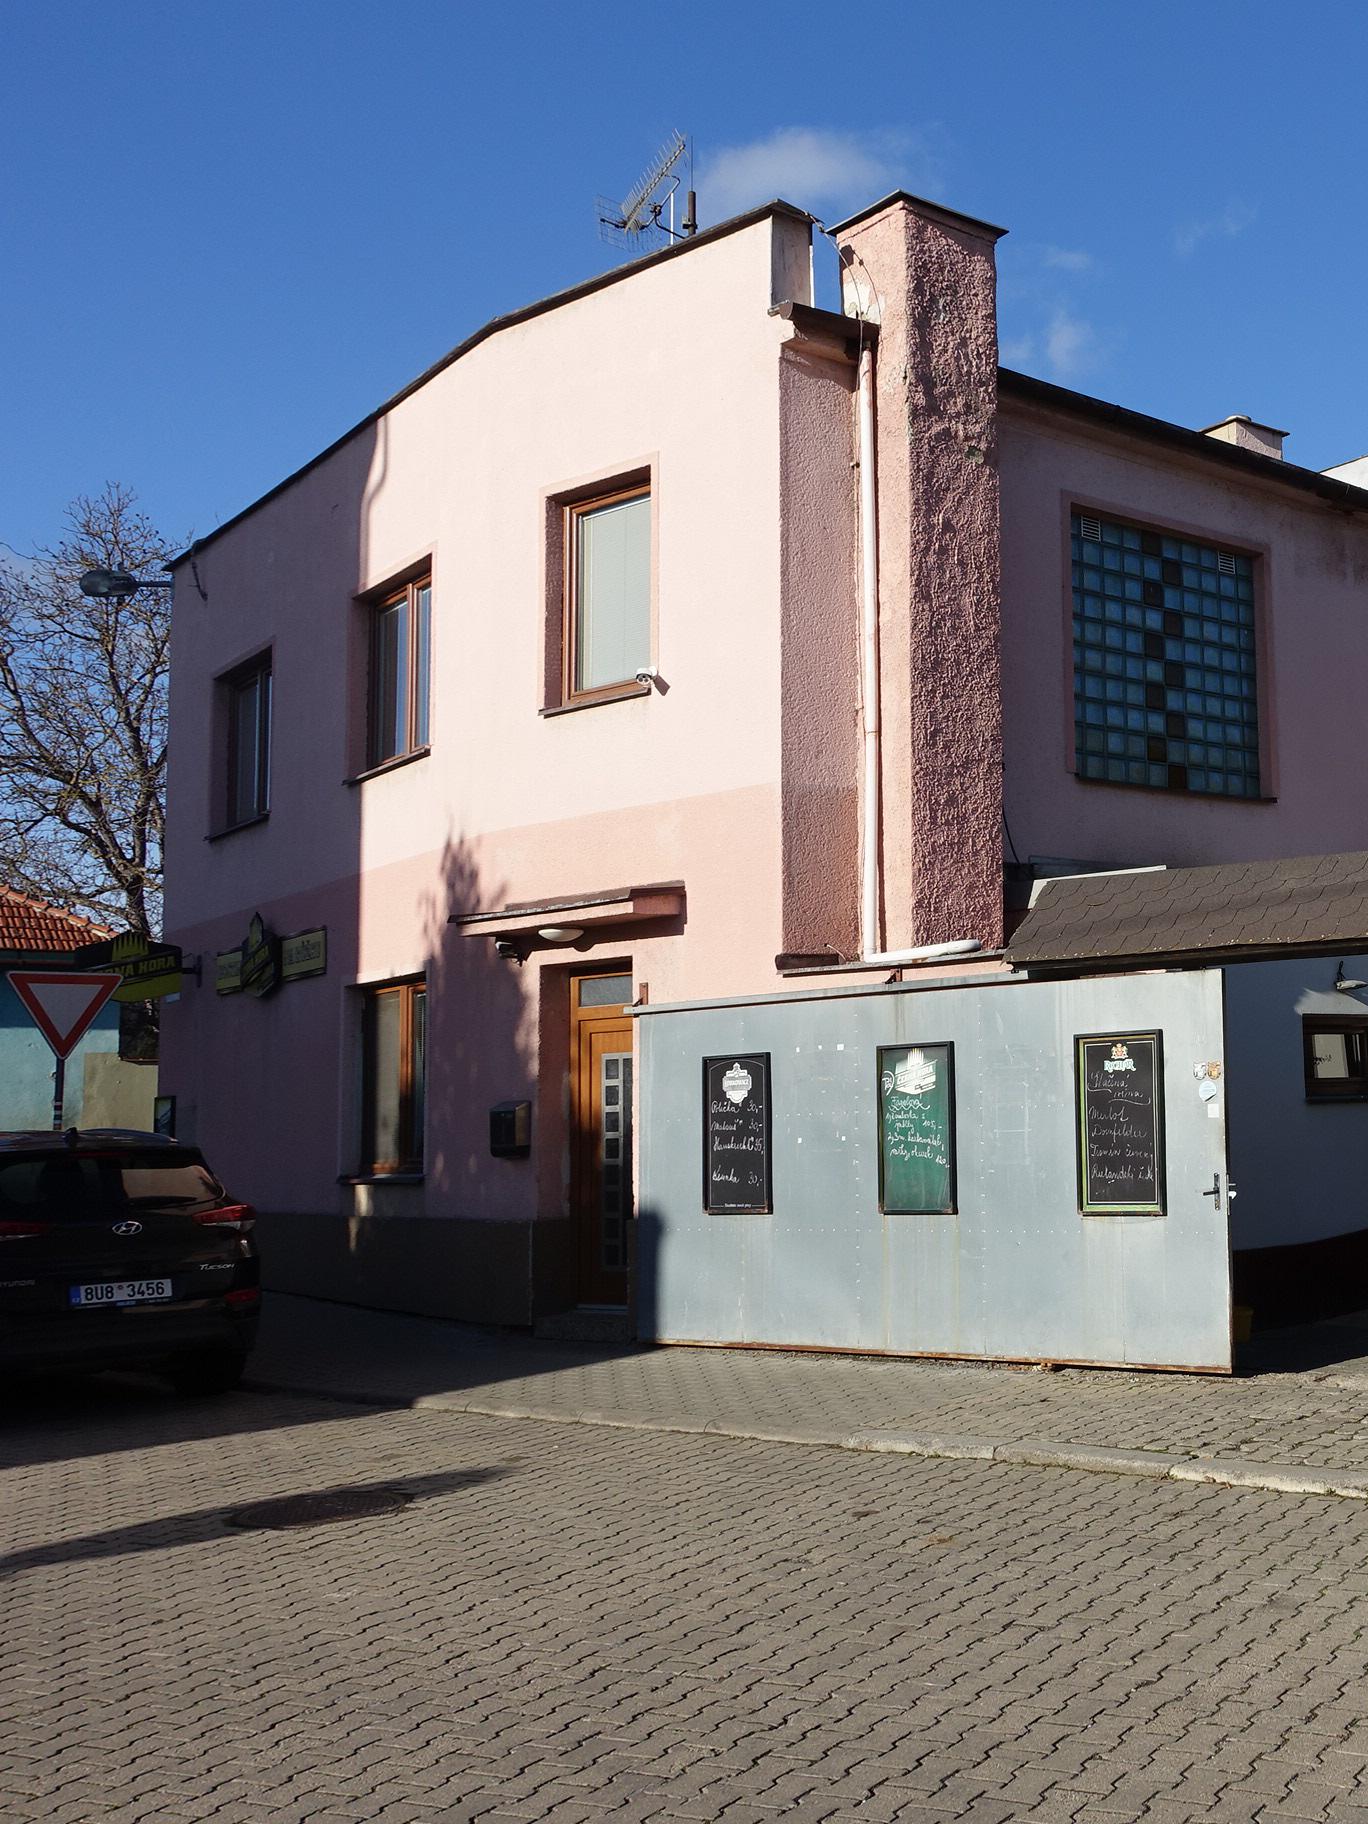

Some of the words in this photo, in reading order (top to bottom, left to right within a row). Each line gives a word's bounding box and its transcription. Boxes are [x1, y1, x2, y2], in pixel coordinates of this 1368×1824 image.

[138, 955, 177, 975] HORA
[199, 1263, 235, 1272] TUCSON
[84, 1285, 114, 1301] 8U8
[127, 1281, 165, 1298] 3456
